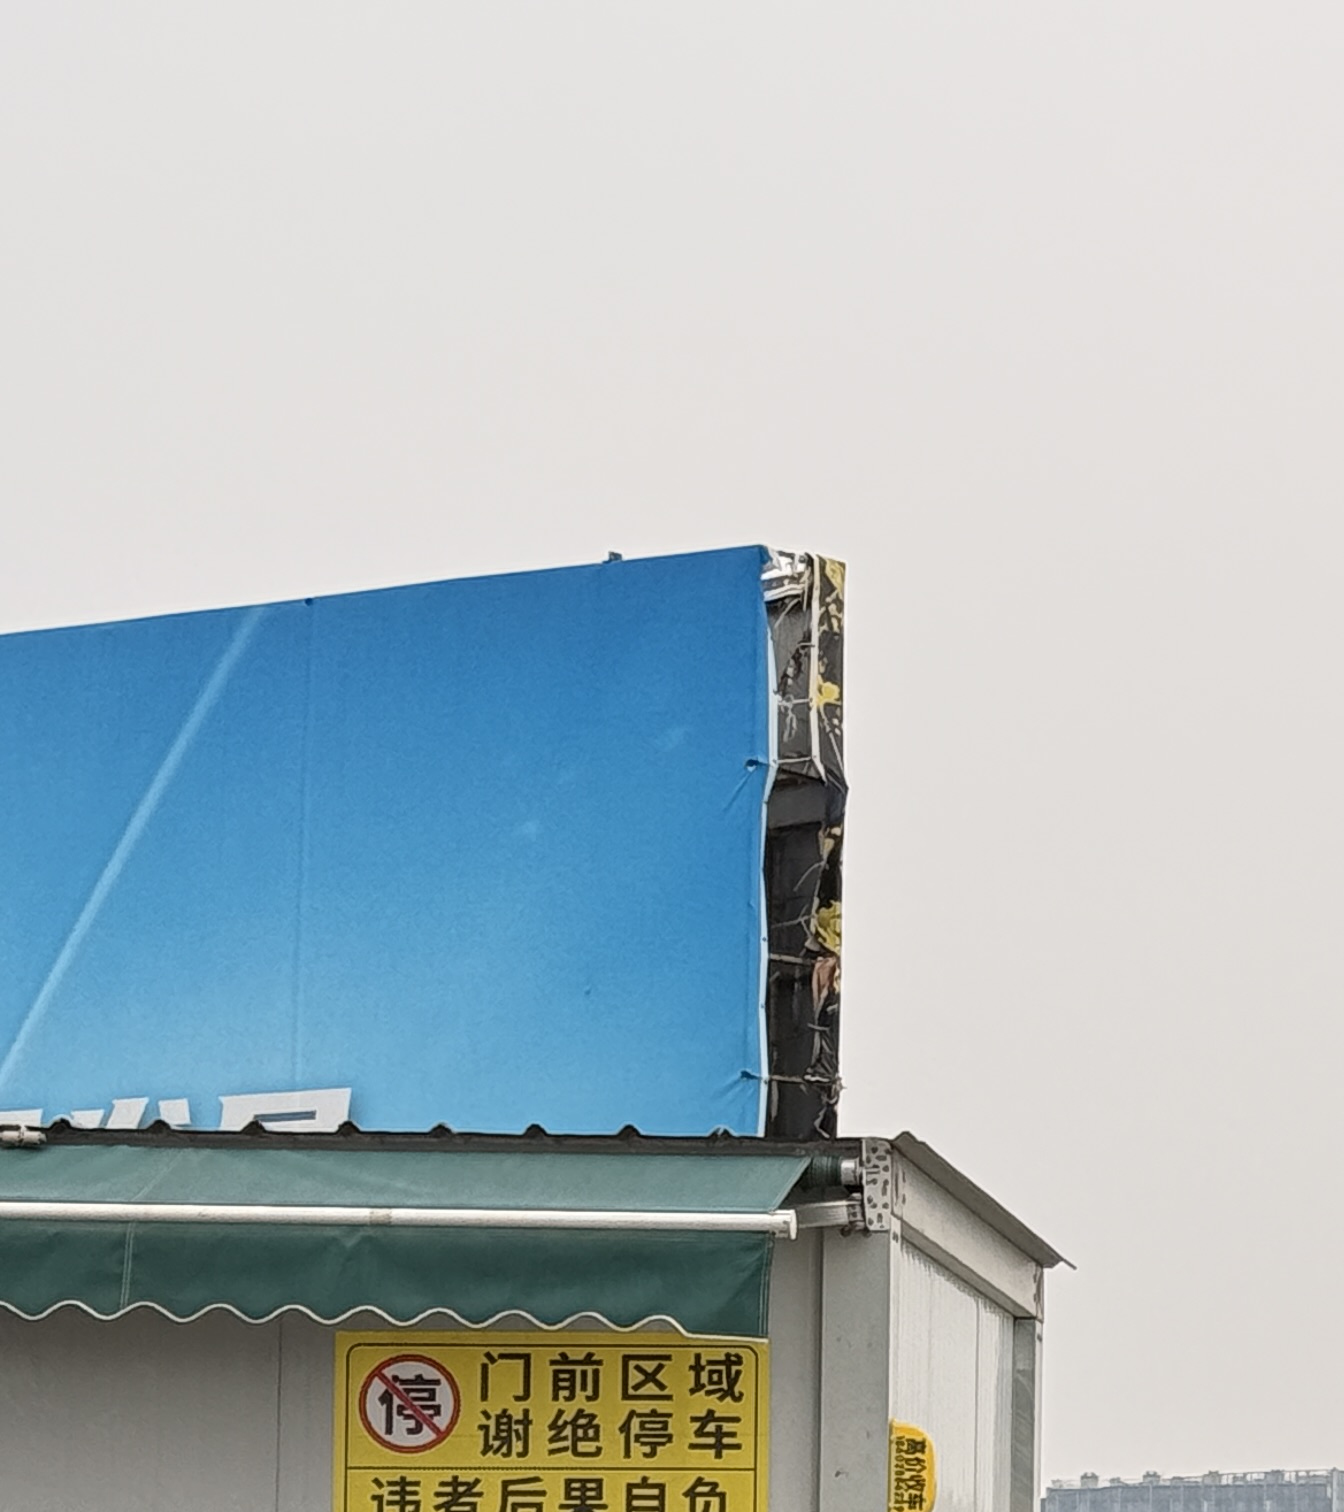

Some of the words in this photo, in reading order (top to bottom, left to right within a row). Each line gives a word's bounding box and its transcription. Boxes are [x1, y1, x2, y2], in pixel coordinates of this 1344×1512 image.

[478, 1351, 744, 1404] 门前区域
[477, 1408, 743, 1460] 谢绝停车
